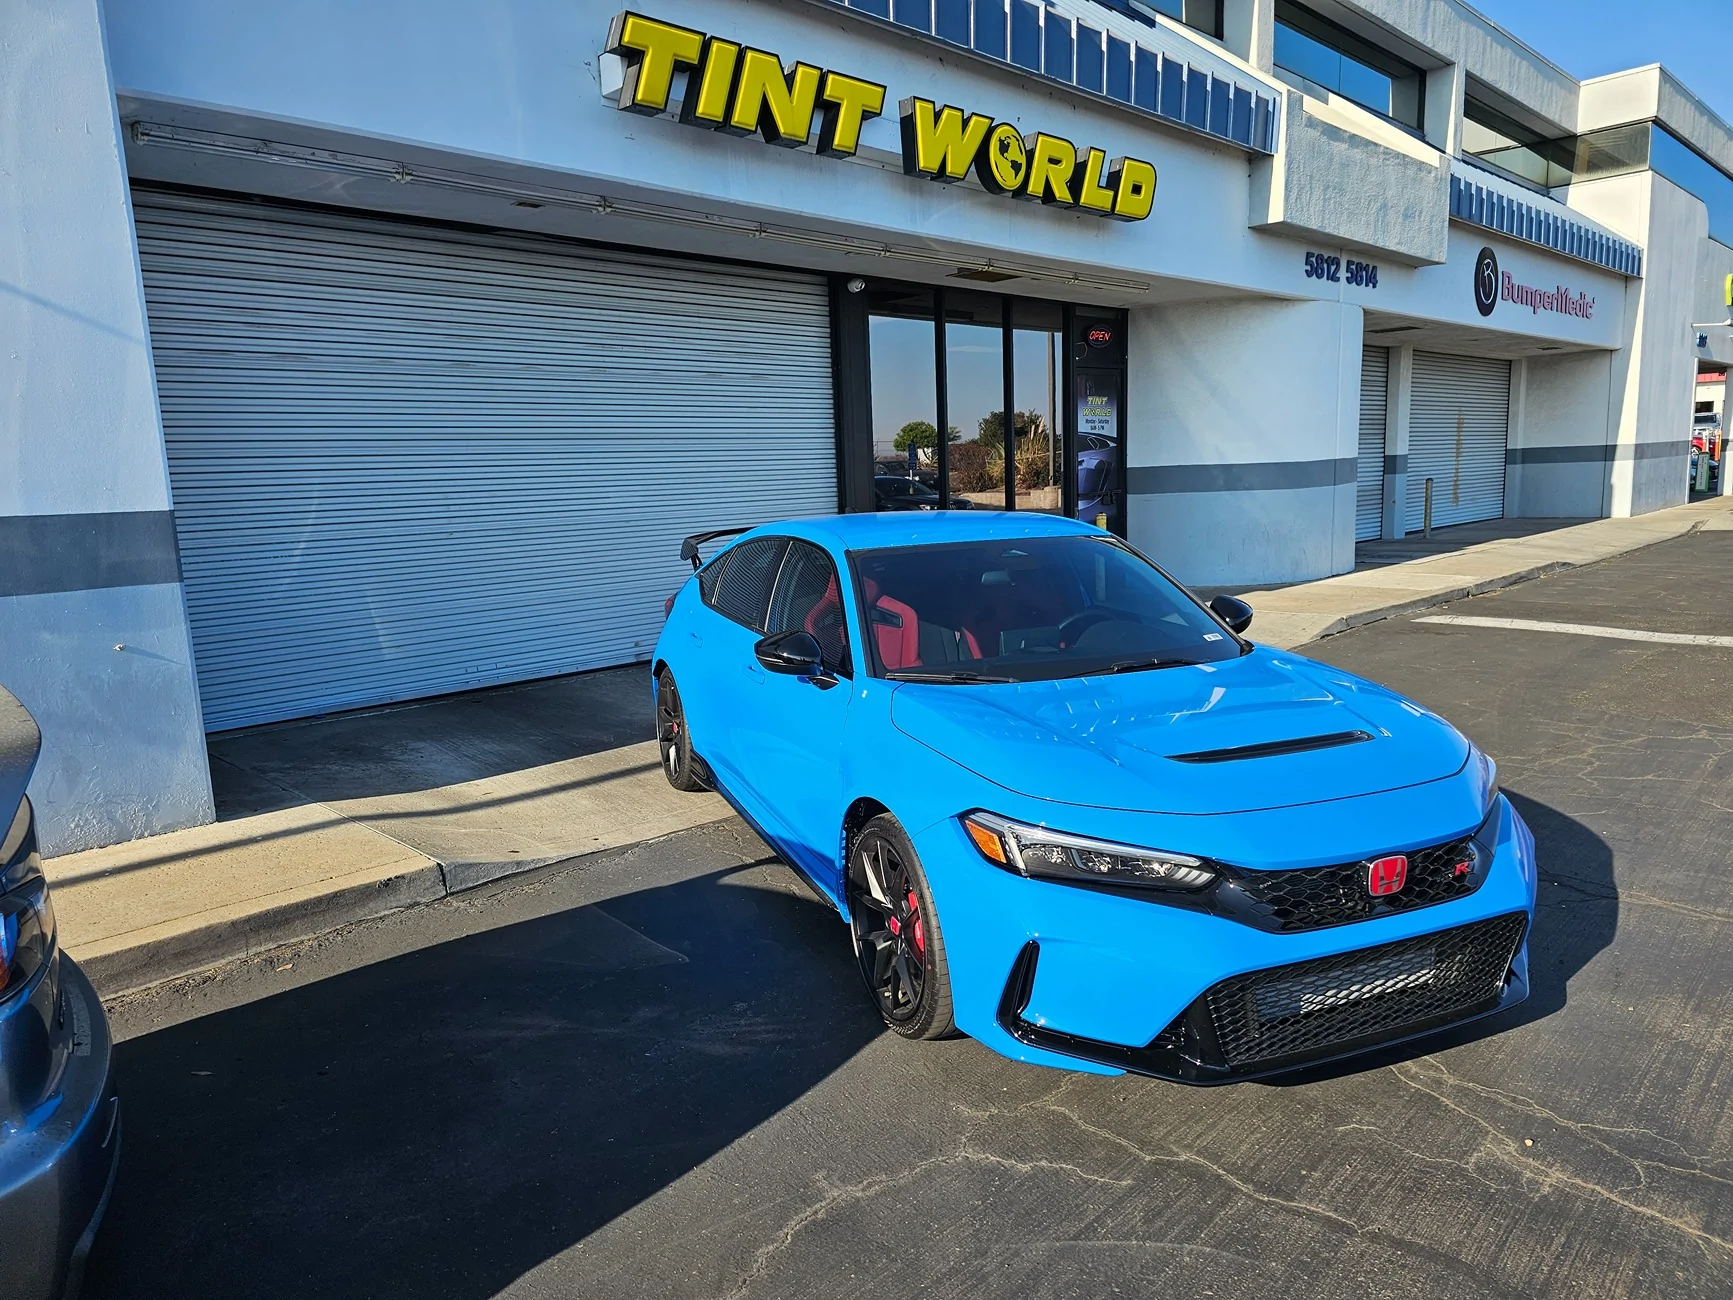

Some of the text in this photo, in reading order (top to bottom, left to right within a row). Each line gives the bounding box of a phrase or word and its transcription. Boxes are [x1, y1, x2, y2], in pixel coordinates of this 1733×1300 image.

[610, 10, 1158, 222] TINT WORLD
[1304, 252, 1379, 290] 5812 5814
[1502, 271, 1593, 319] BumperMedic
[1089, 330, 1111, 341] OPEN
[1082, 407, 1112, 416] WORLD
[1087, 396, 1109, 405] TINT
